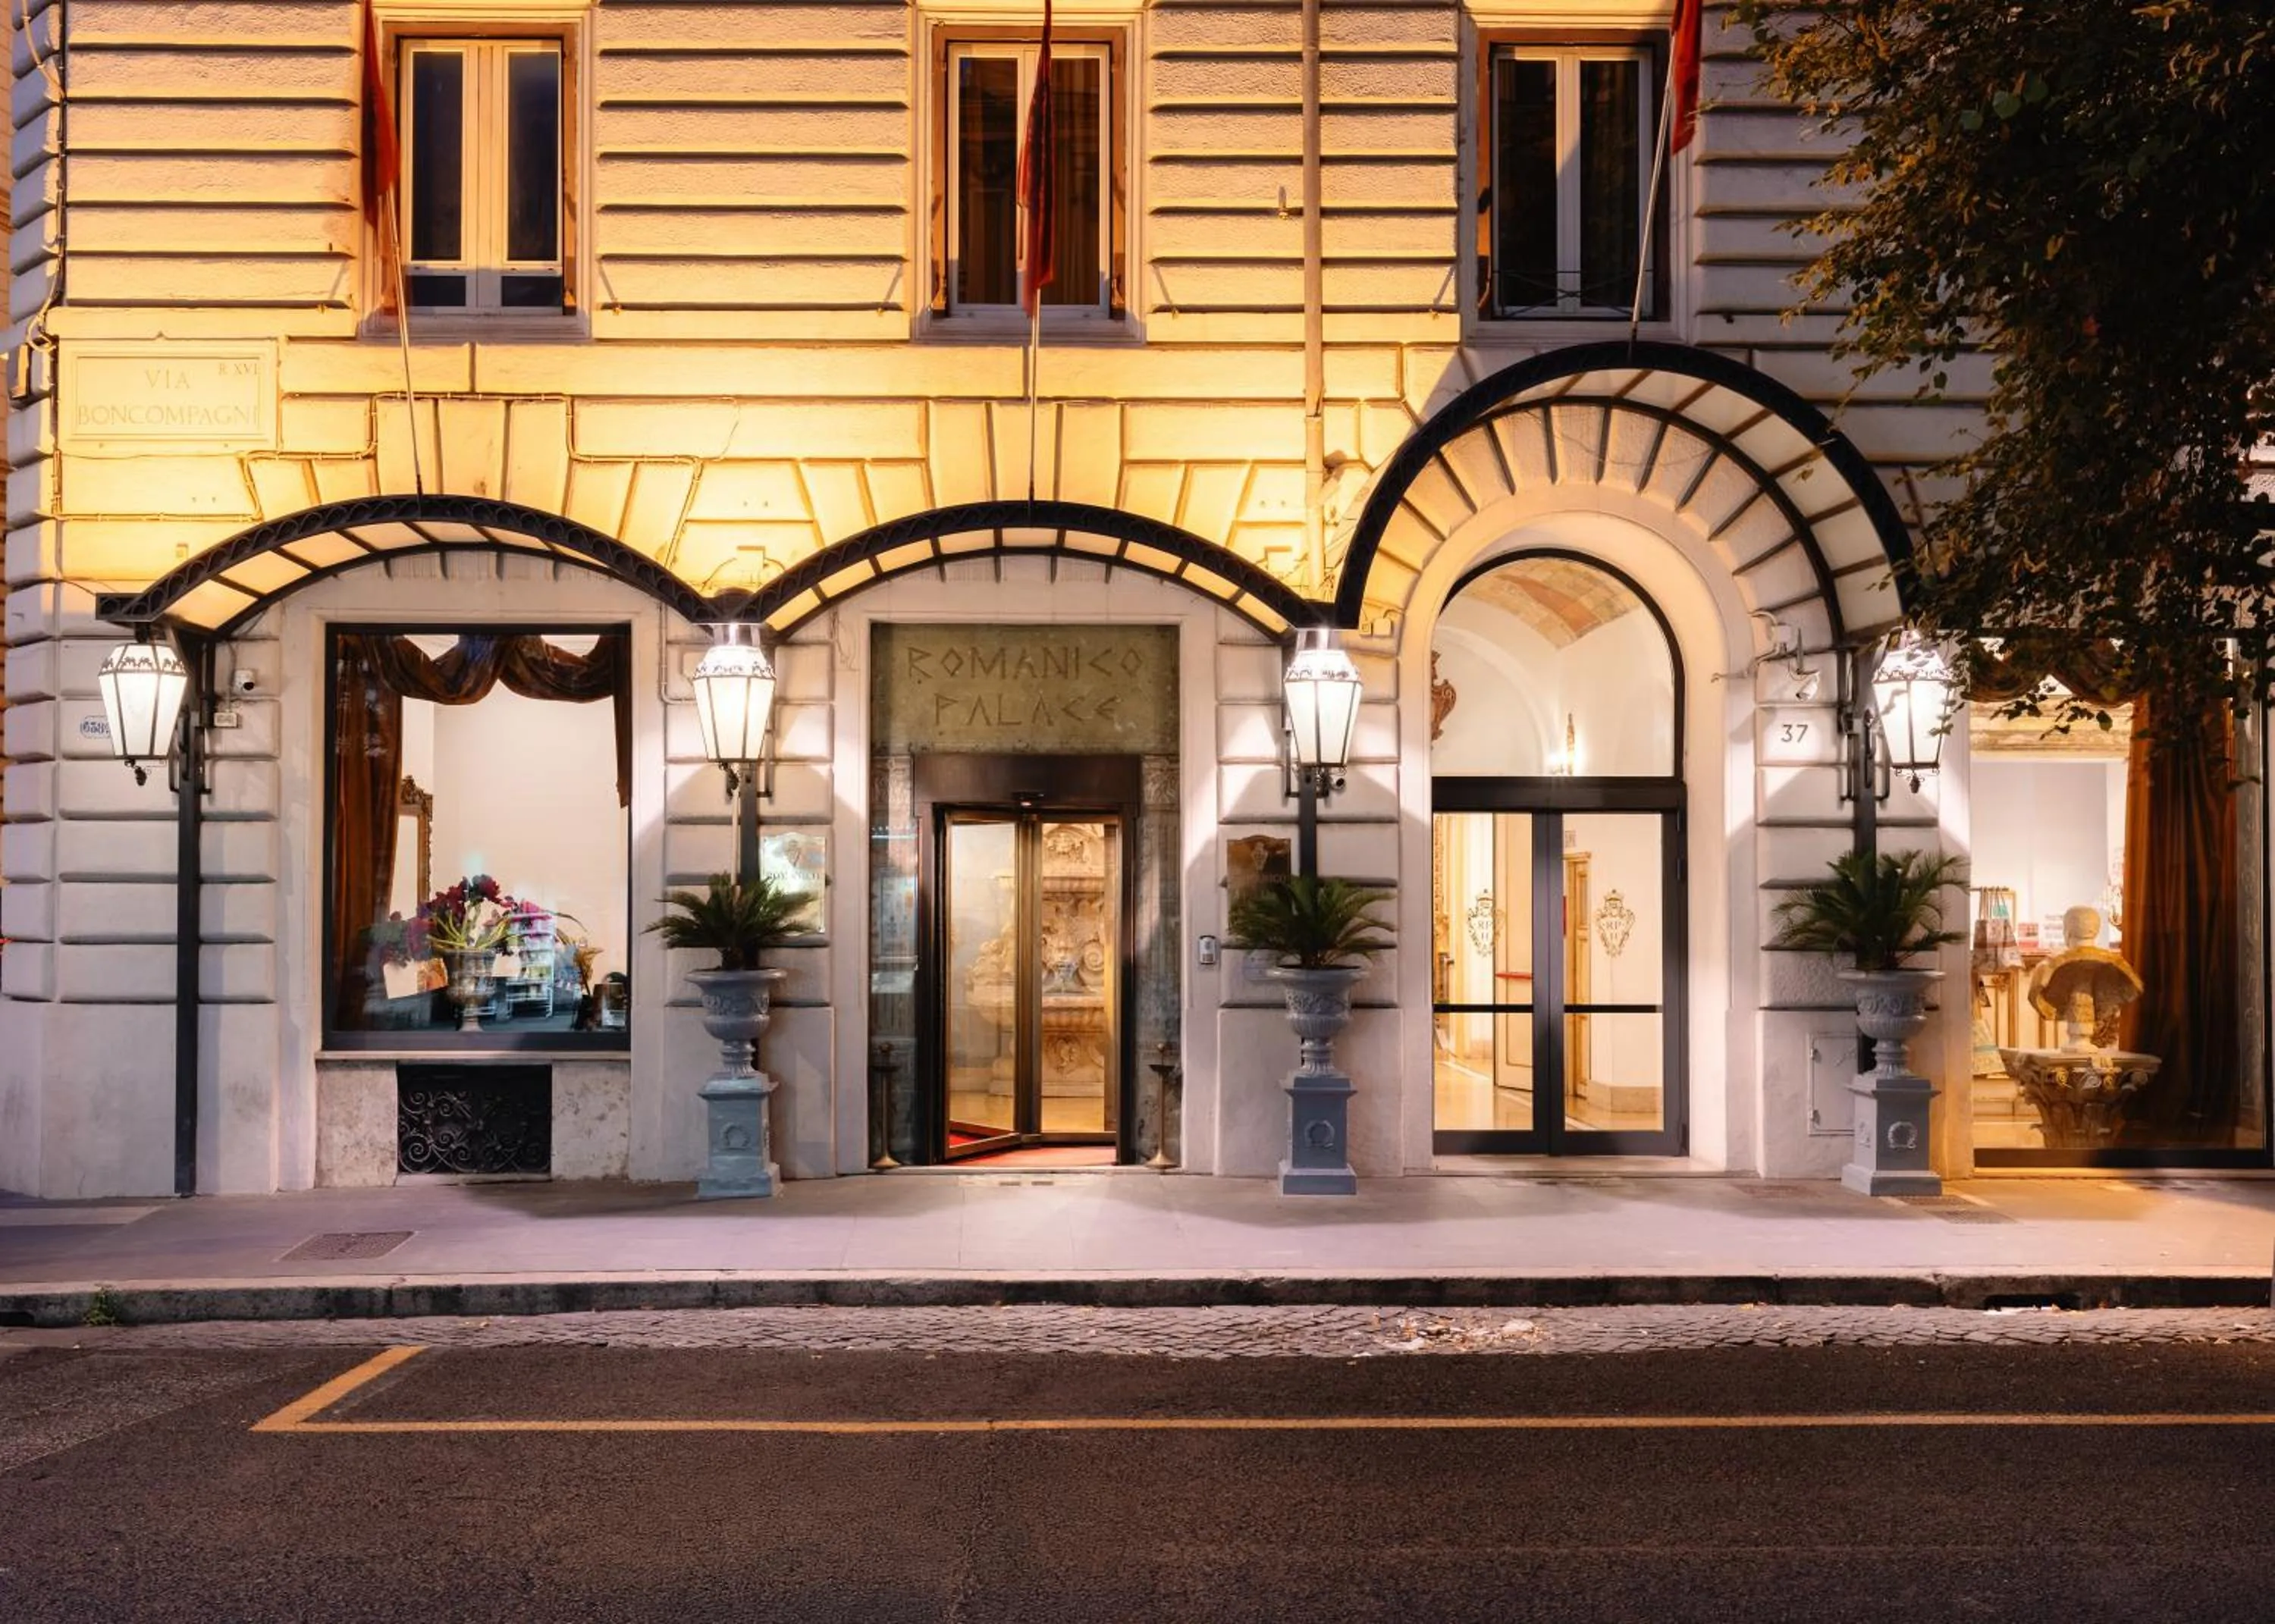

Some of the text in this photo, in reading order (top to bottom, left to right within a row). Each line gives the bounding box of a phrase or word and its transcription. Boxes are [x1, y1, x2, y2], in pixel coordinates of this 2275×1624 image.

[144, 368, 191, 390] VIA
[77, 404, 259, 426] BONCOMPAGNI
[907, 646, 1144, 679] ROMANICO
[934, 691, 1122, 727] PALACE
[1781, 724, 1809, 743] 37
